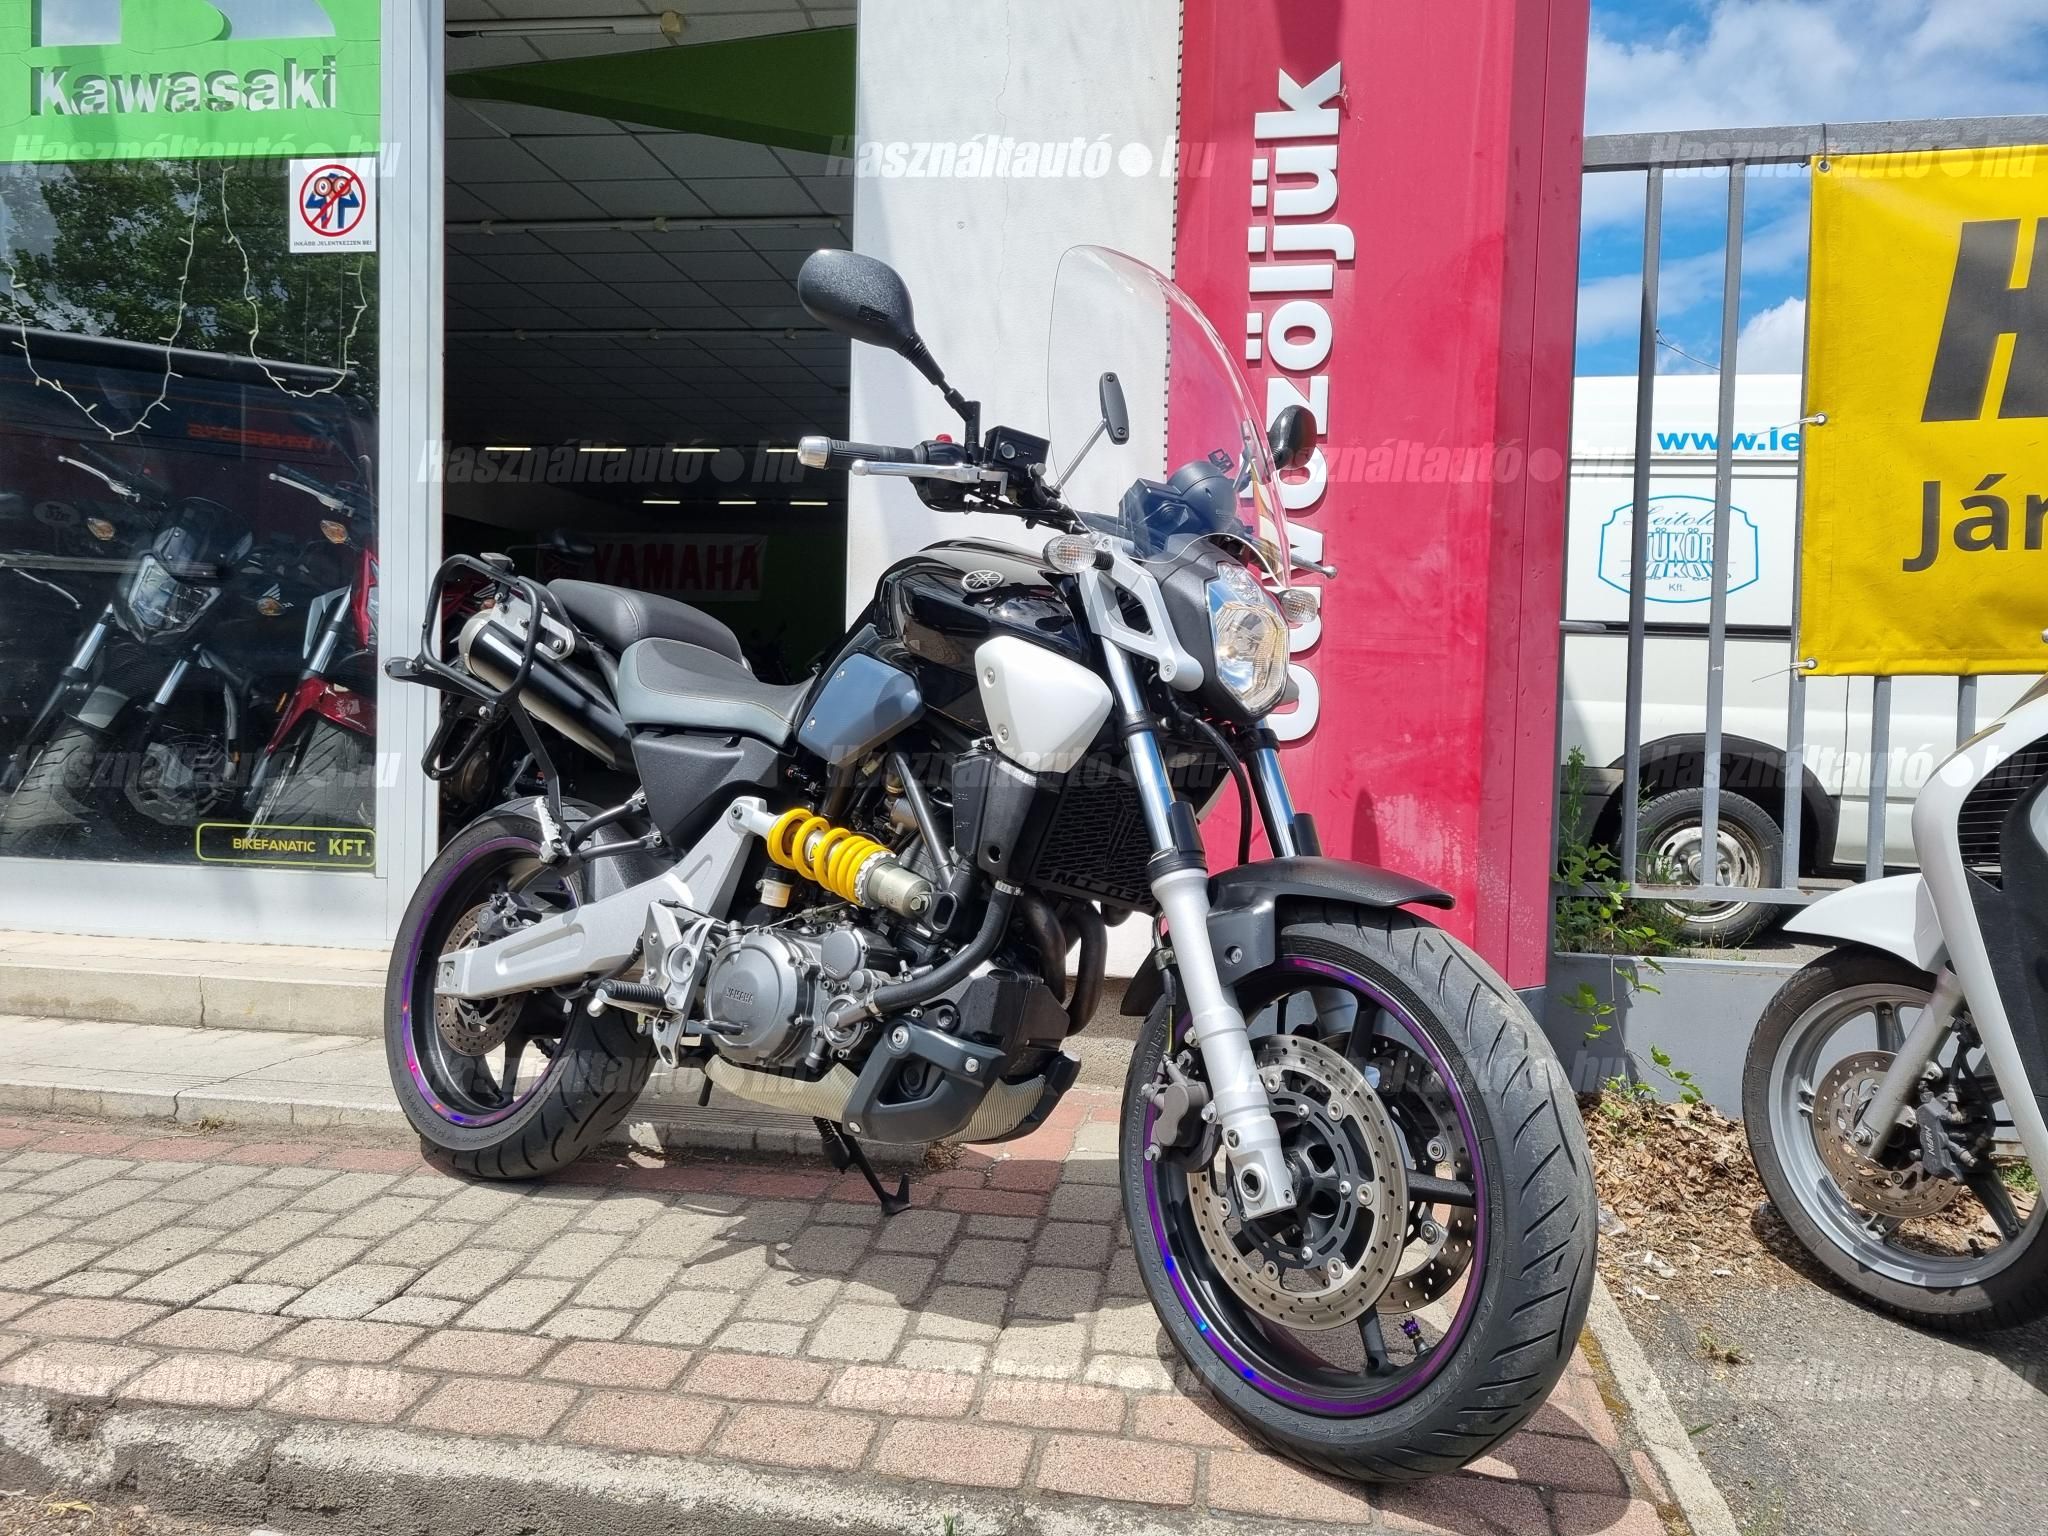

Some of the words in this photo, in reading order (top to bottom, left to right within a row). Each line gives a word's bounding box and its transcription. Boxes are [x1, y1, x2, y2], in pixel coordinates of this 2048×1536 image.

[34, 57, 337, 115] Kawasaki
[595, 543, 760, 592] YAMAHA
[1669, 583, 1686, 591] Kft.
[233, 838, 316, 853] BIKEFANATIC
[329, 838, 371, 857] KFT.
